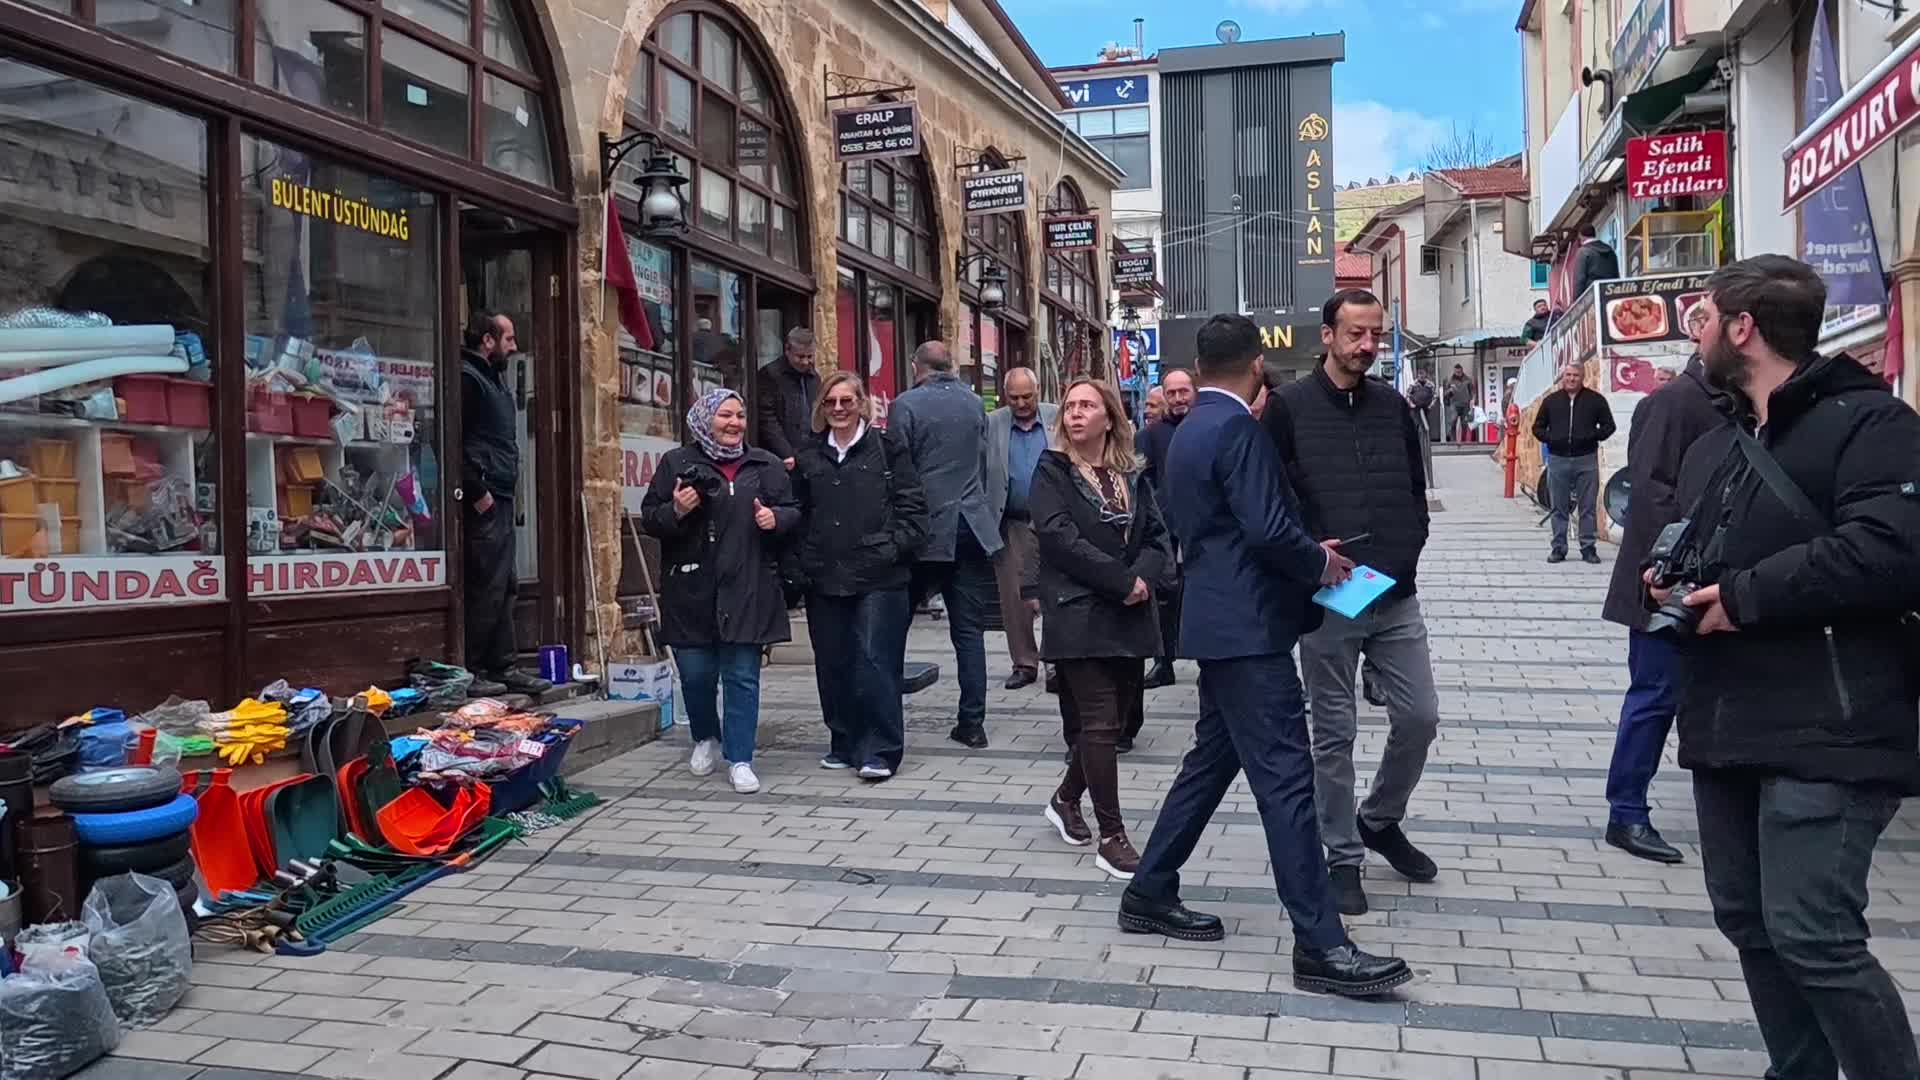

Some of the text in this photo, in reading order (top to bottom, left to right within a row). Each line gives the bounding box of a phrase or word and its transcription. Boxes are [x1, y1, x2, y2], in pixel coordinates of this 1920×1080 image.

[856, 110, 894, 125] ERALP
[841, 143, 864, 152] 0535
[899, 138, 913, 146] 00
[1648, 136, 1703, 156] Salih
[1788, 78, 1899, 198] BOZKURT
[1641, 155, 1712, 180] Efendi
[965, 174, 1023, 188] BURCUM
[1632, 176, 1724, 197] Tatlıları
[271, 174, 410, 241] BÜLENT ÜSTÜNDAĞ
[1306, 149, 1322, 255] ASLAN
[1049, 221, 1092, 232] NUR ÇELİK
[1605, 282, 1638, 295] Salih
[1641, 279, 1684, 294] Efendi
[0, 557, 440, 604] TÜNDAĞ HIRDAVAT
